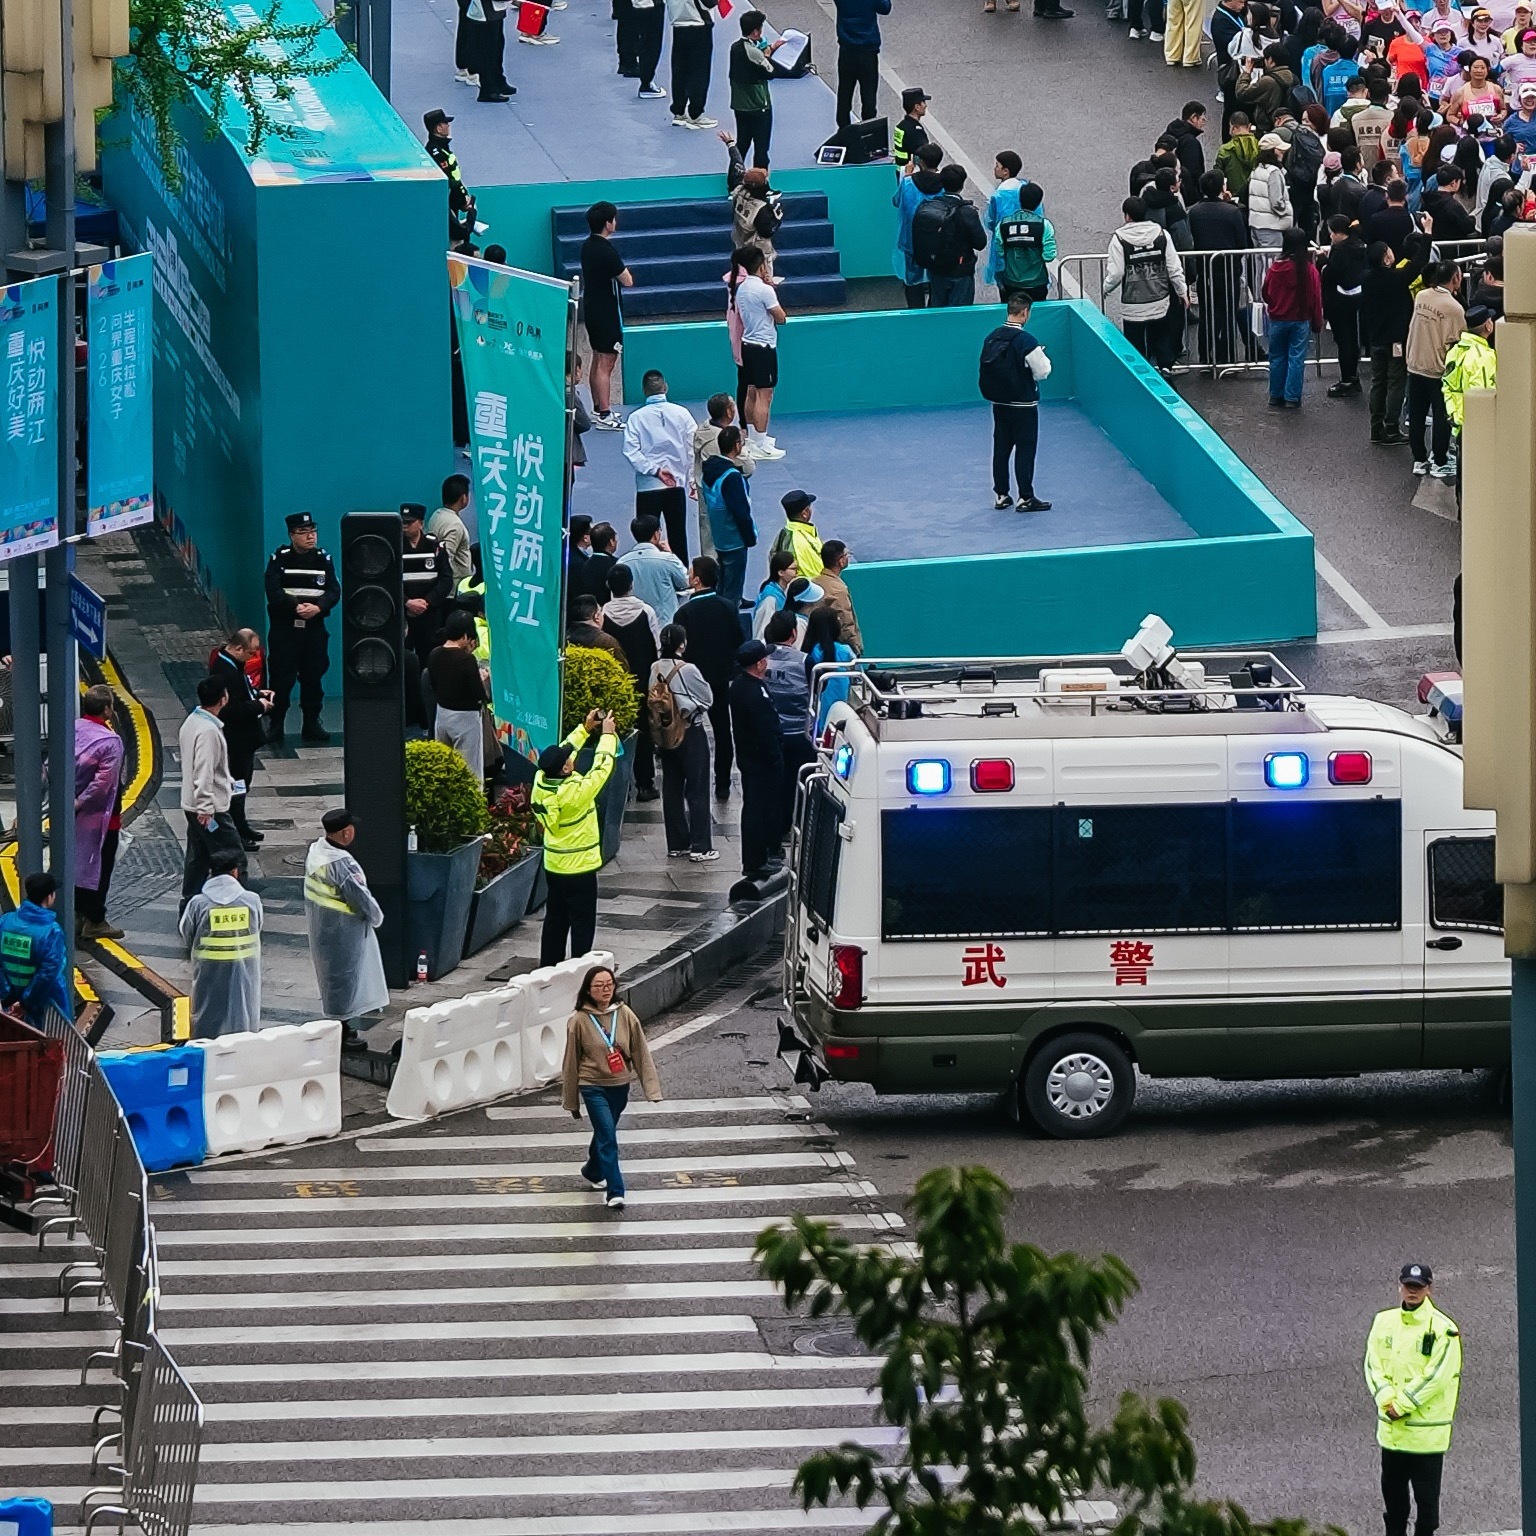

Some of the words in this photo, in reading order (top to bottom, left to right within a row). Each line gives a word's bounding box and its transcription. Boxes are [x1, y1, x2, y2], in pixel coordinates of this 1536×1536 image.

[6, 330, 26, 442] 重庆好美
[26, 336, 46, 445] 悦动两江
[110, 313, 123, 420] 问界重庆女子
[123, 309, 136, 399] 半程马拉松
[509, 431, 545, 627] 悦动两江
[214, 914, 247, 924] 重庆保安
